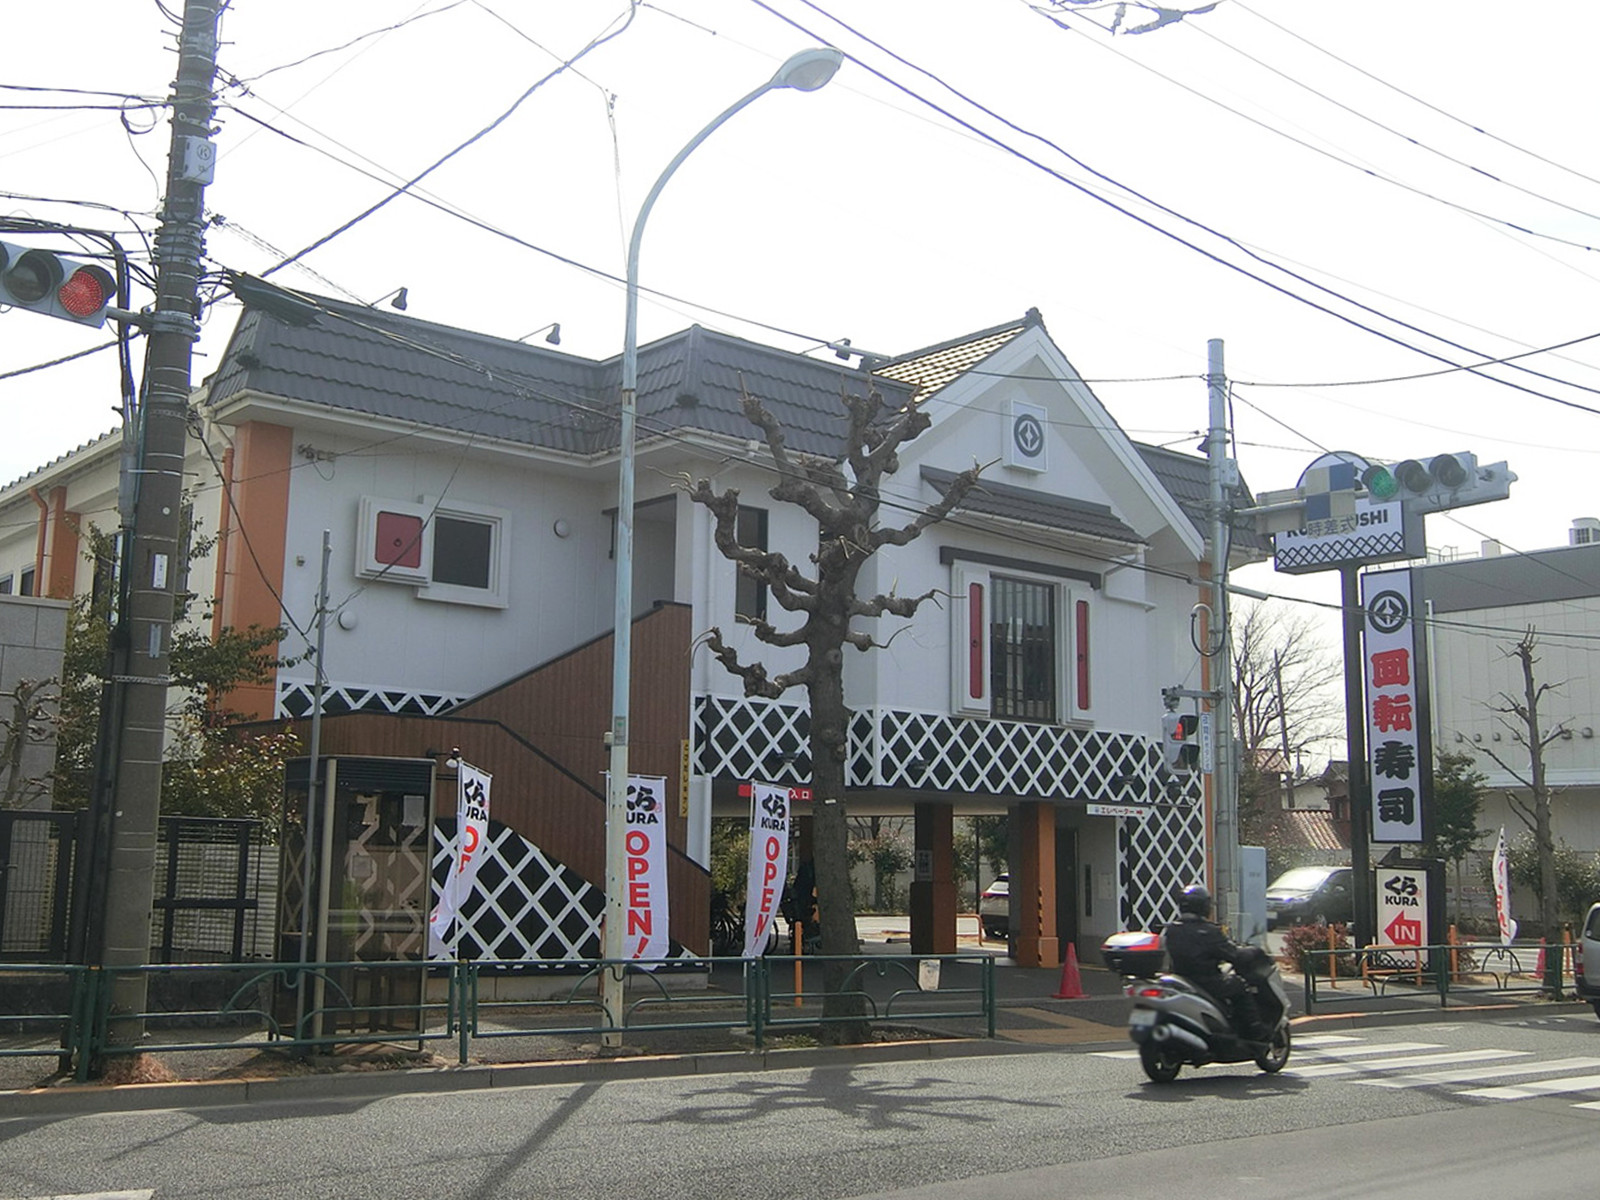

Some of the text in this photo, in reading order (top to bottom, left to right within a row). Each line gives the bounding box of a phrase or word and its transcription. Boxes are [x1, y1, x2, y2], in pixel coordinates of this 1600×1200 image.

[1307, 514, 1356, 537] 時差式
[1370, 648, 1415, 826] 回転寿司
[762, 793, 786, 819] くら
[626, 812, 658, 824] URA
[761, 817, 787, 832] KURA
[1384, 875, 1418, 896] くら
[1385, 895, 1419, 906] KURA
[1394, 924, 1416, 941] IN
